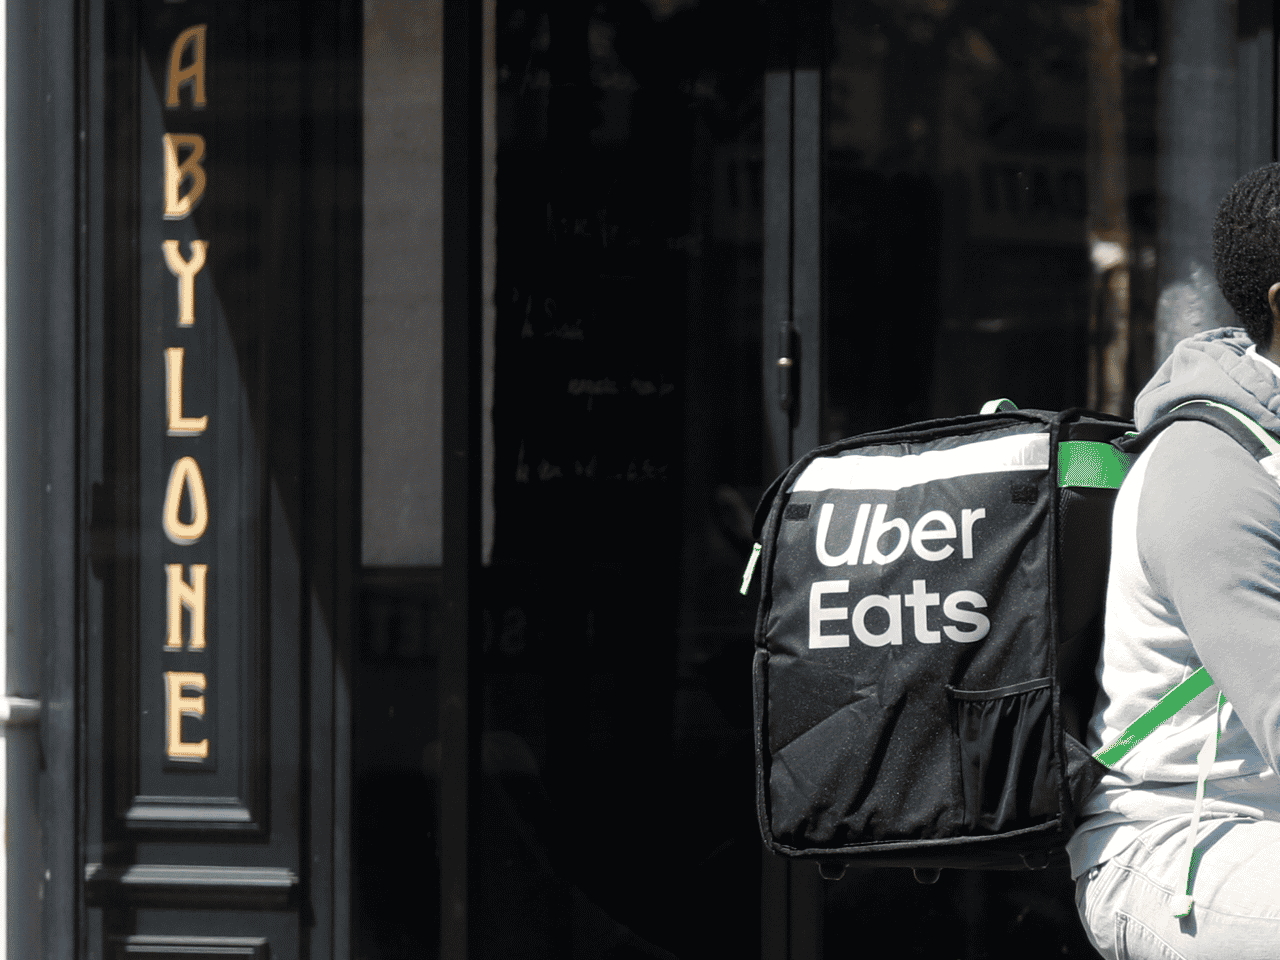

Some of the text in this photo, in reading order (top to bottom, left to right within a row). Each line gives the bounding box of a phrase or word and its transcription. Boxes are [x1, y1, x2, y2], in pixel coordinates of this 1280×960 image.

[161, 0, 209, 763] ABYLONE
[815, 502, 986, 567] Uber
[808, 579, 991, 650] Eats
